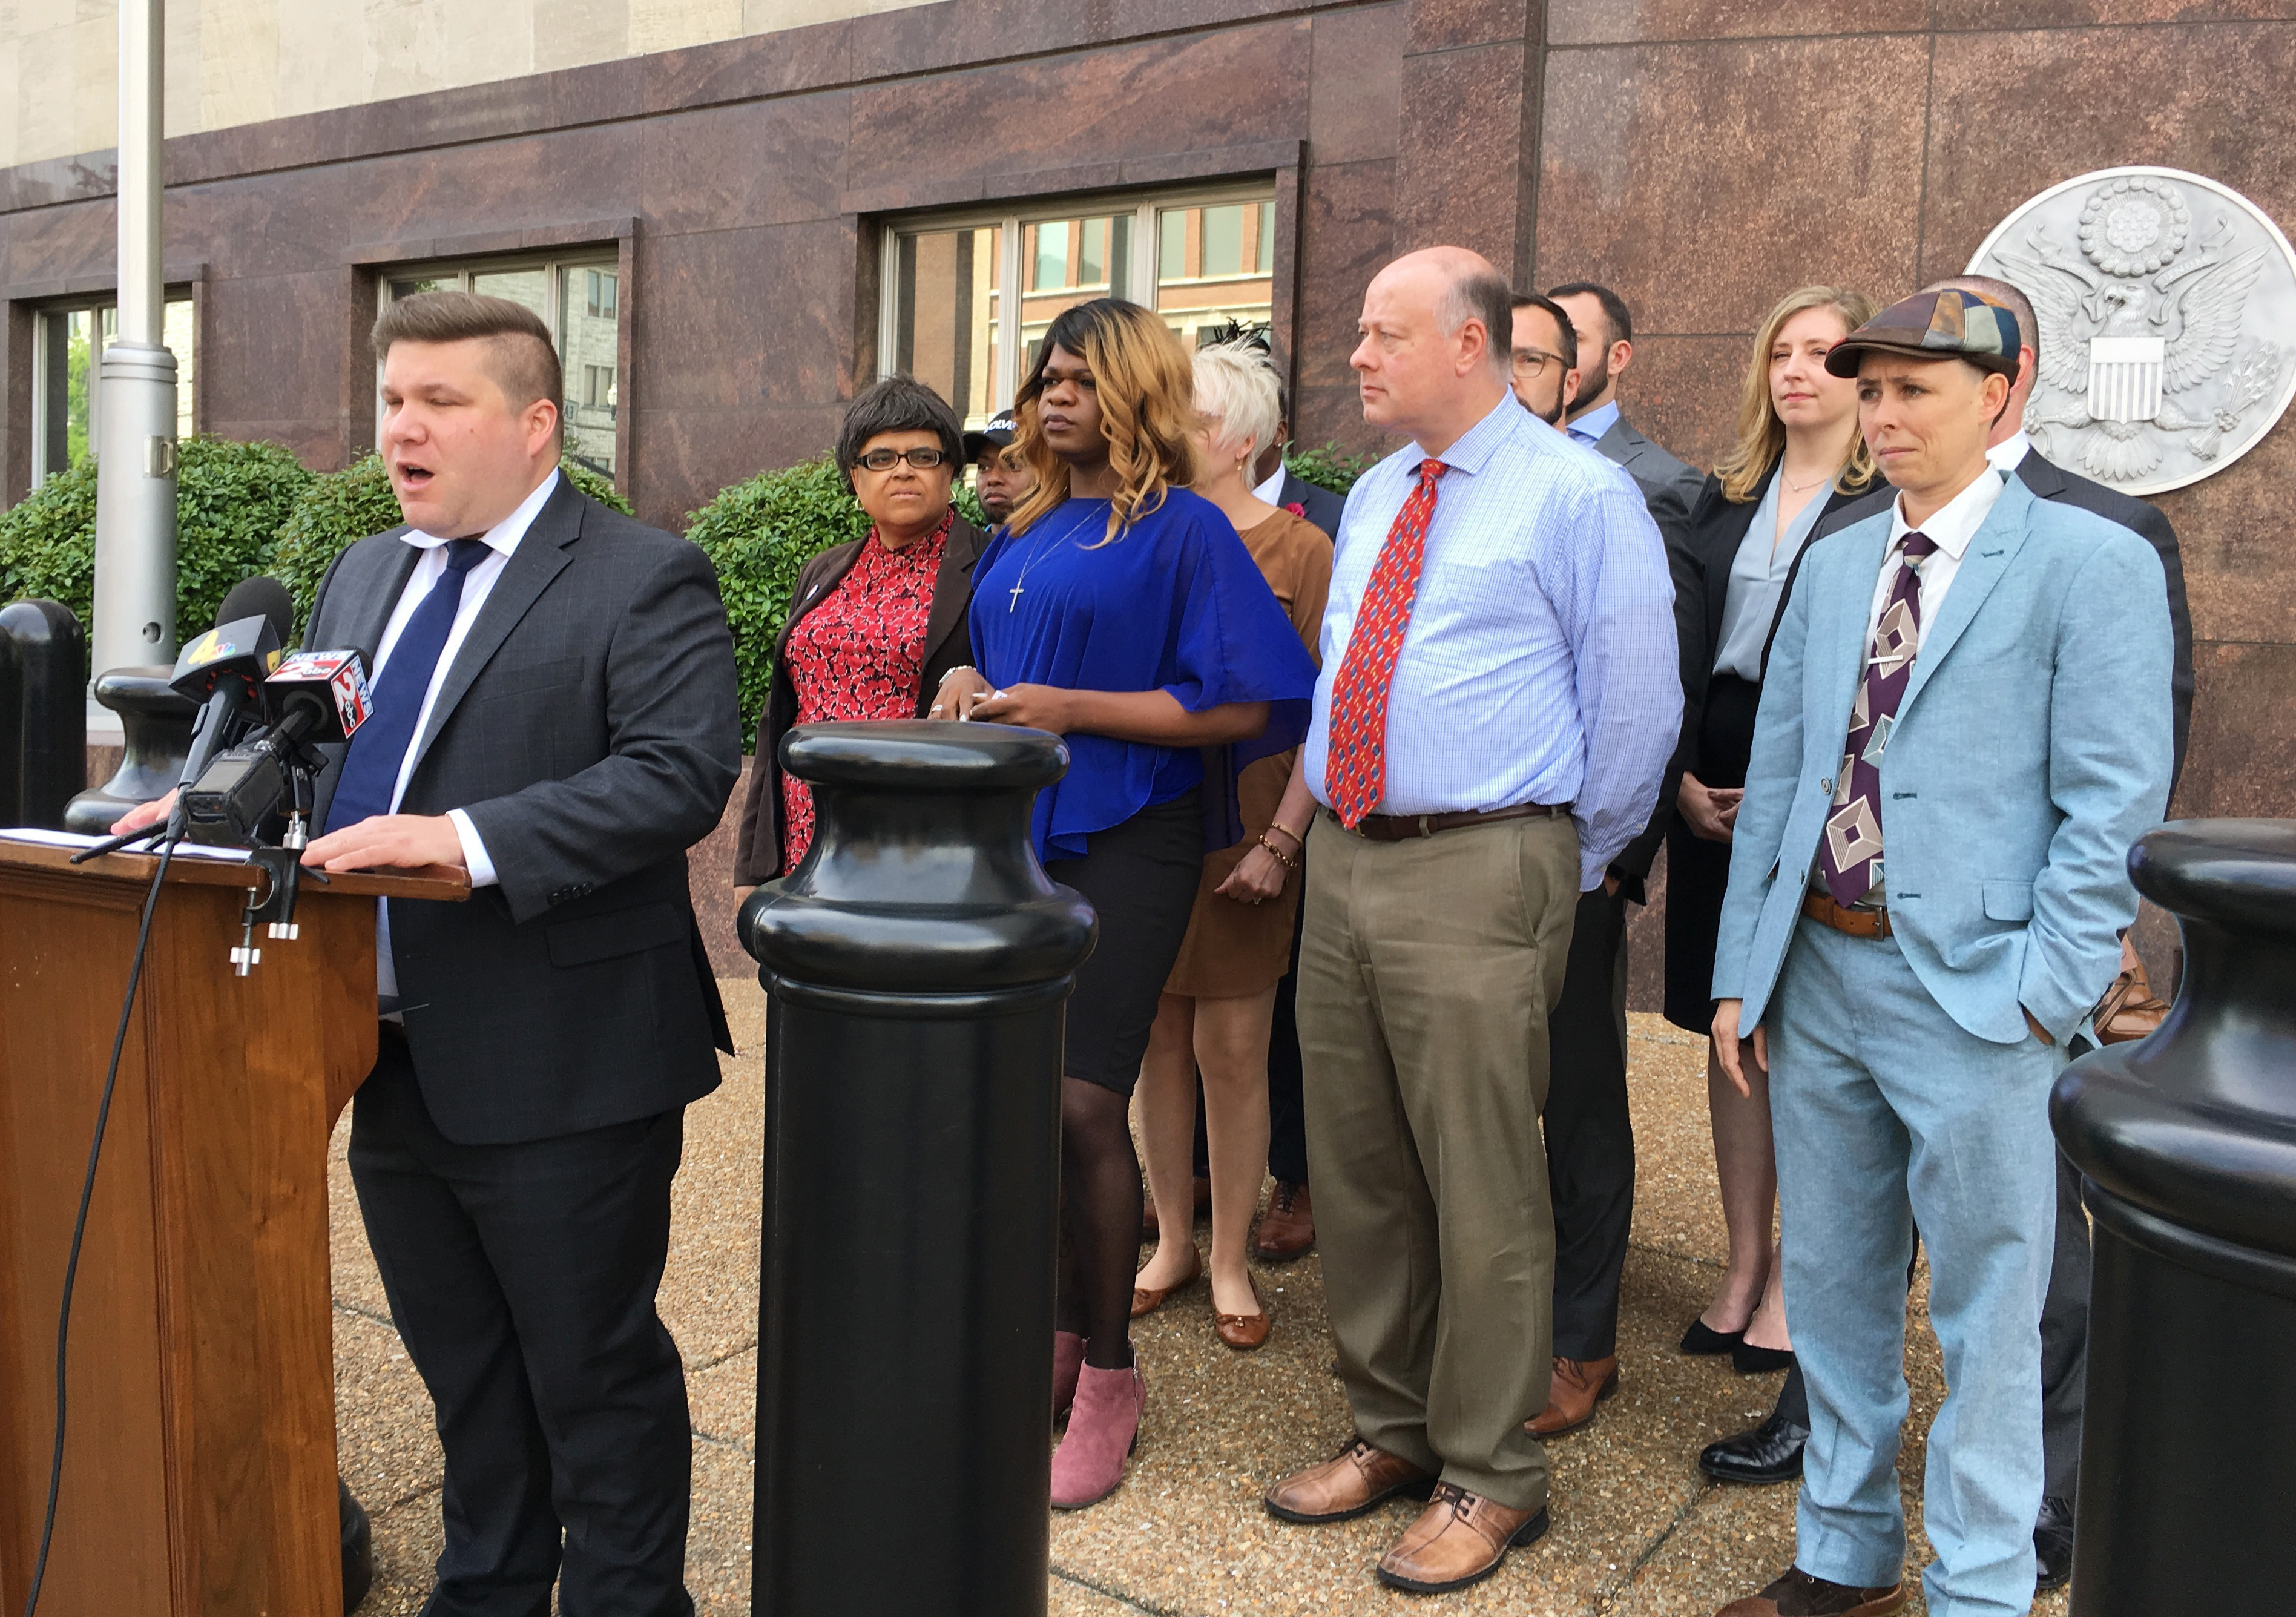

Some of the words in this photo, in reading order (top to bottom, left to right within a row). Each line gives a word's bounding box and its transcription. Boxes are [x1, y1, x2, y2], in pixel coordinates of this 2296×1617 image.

[270, 662, 314, 680] 2
[302, 667, 332, 676] abc
[289, 651, 349, 662] NEWS
[333, 671, 356, 713] 2
[352, 660, 372, 717] NEWS
[344, 700, 356, 729] abc
